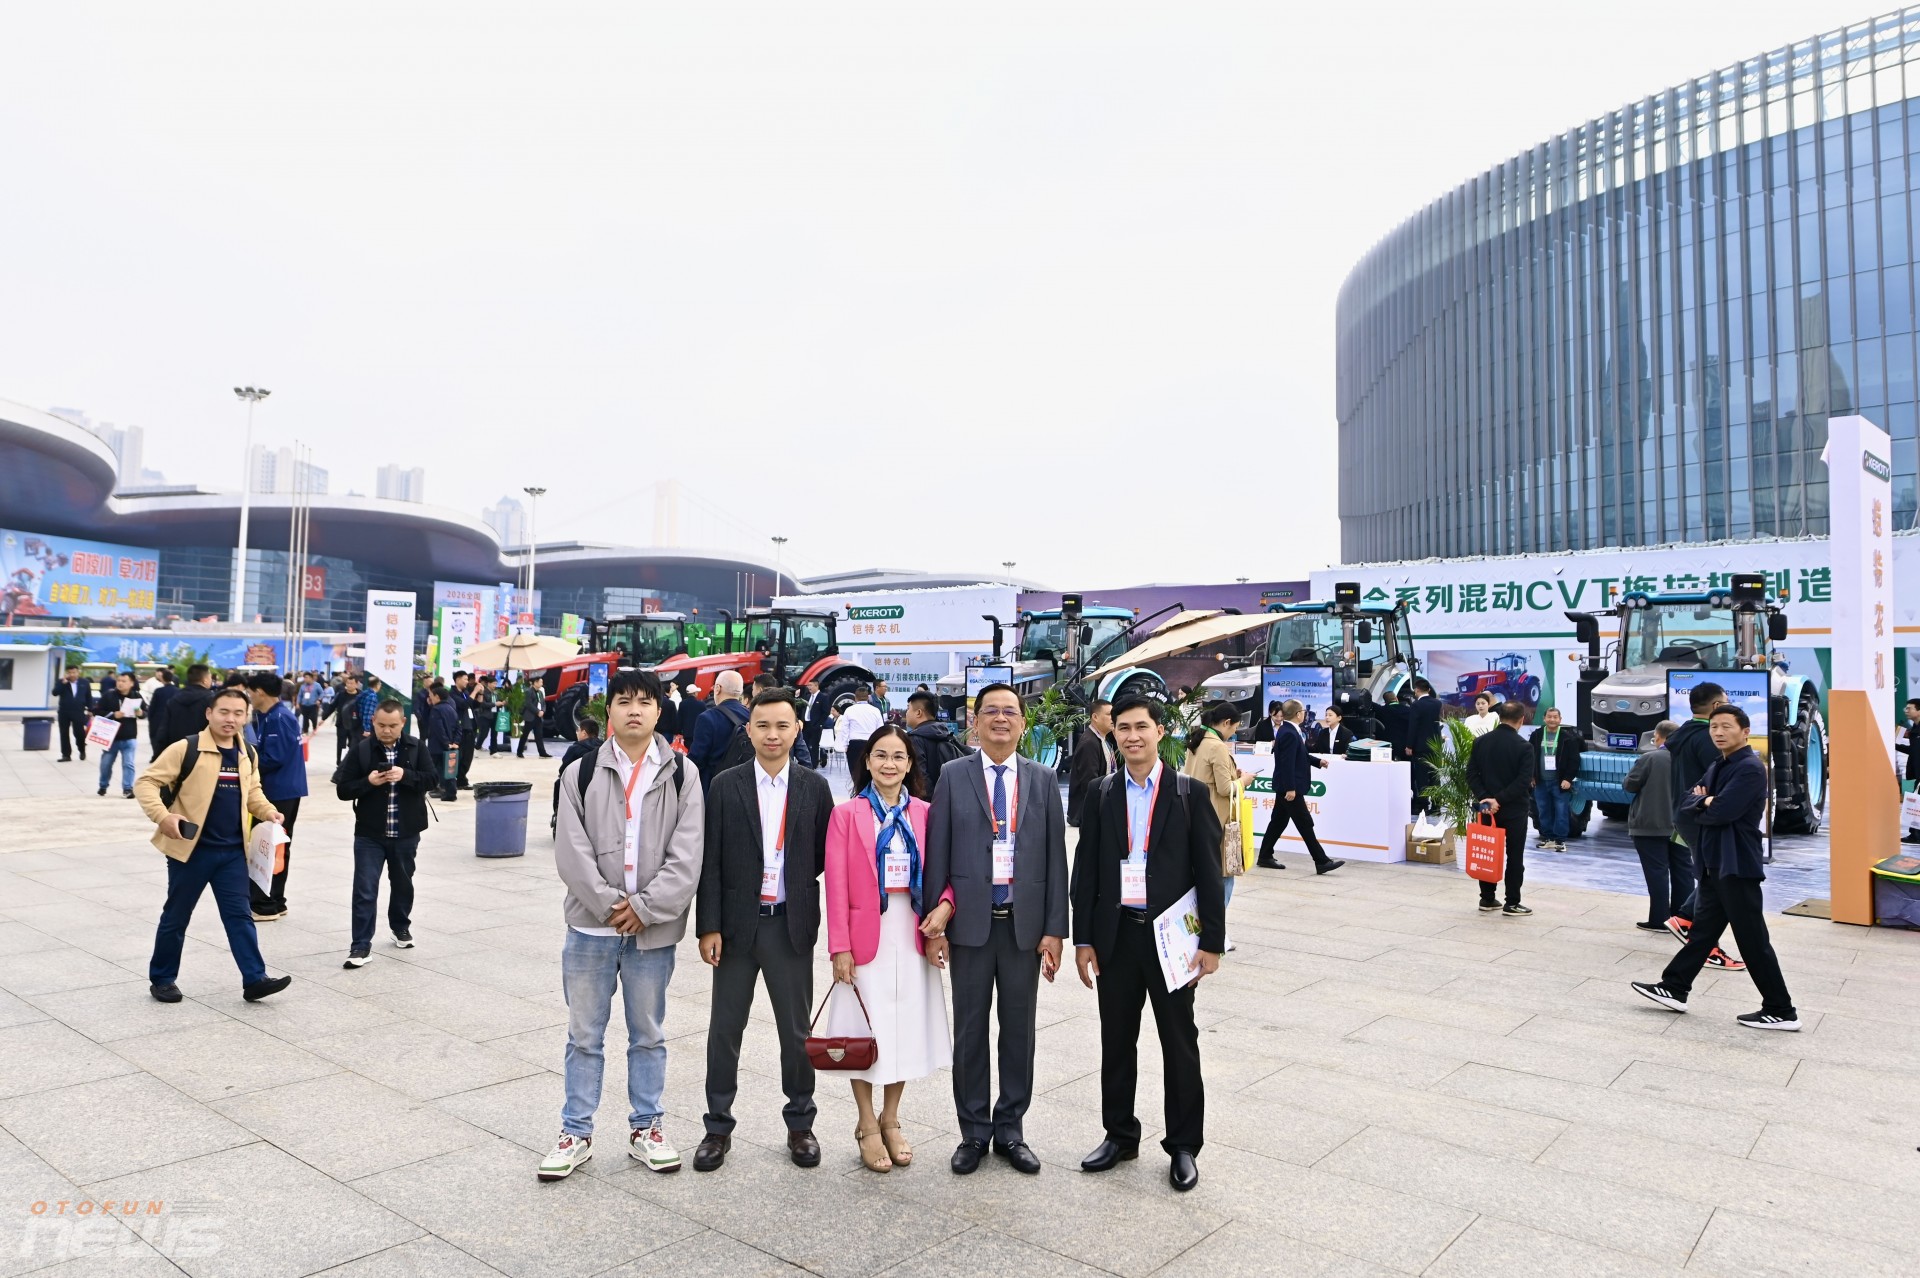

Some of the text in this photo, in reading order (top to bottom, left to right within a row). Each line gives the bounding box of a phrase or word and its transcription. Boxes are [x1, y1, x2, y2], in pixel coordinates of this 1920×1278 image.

[1869, 457, 1889, 477] KEROTY
[305, 575, 322, 591] B3
[860, 605, 900, 617] KEROTY
[853, 624, 900, 634] 铠特农机
[384, 613, 398, 671] 铠特农机
[897, 673, 939, 682] 引领农机新未来
[1254, 780, 1320, 793] KEY
[1244, 797, 1320, 814] 铠特机
